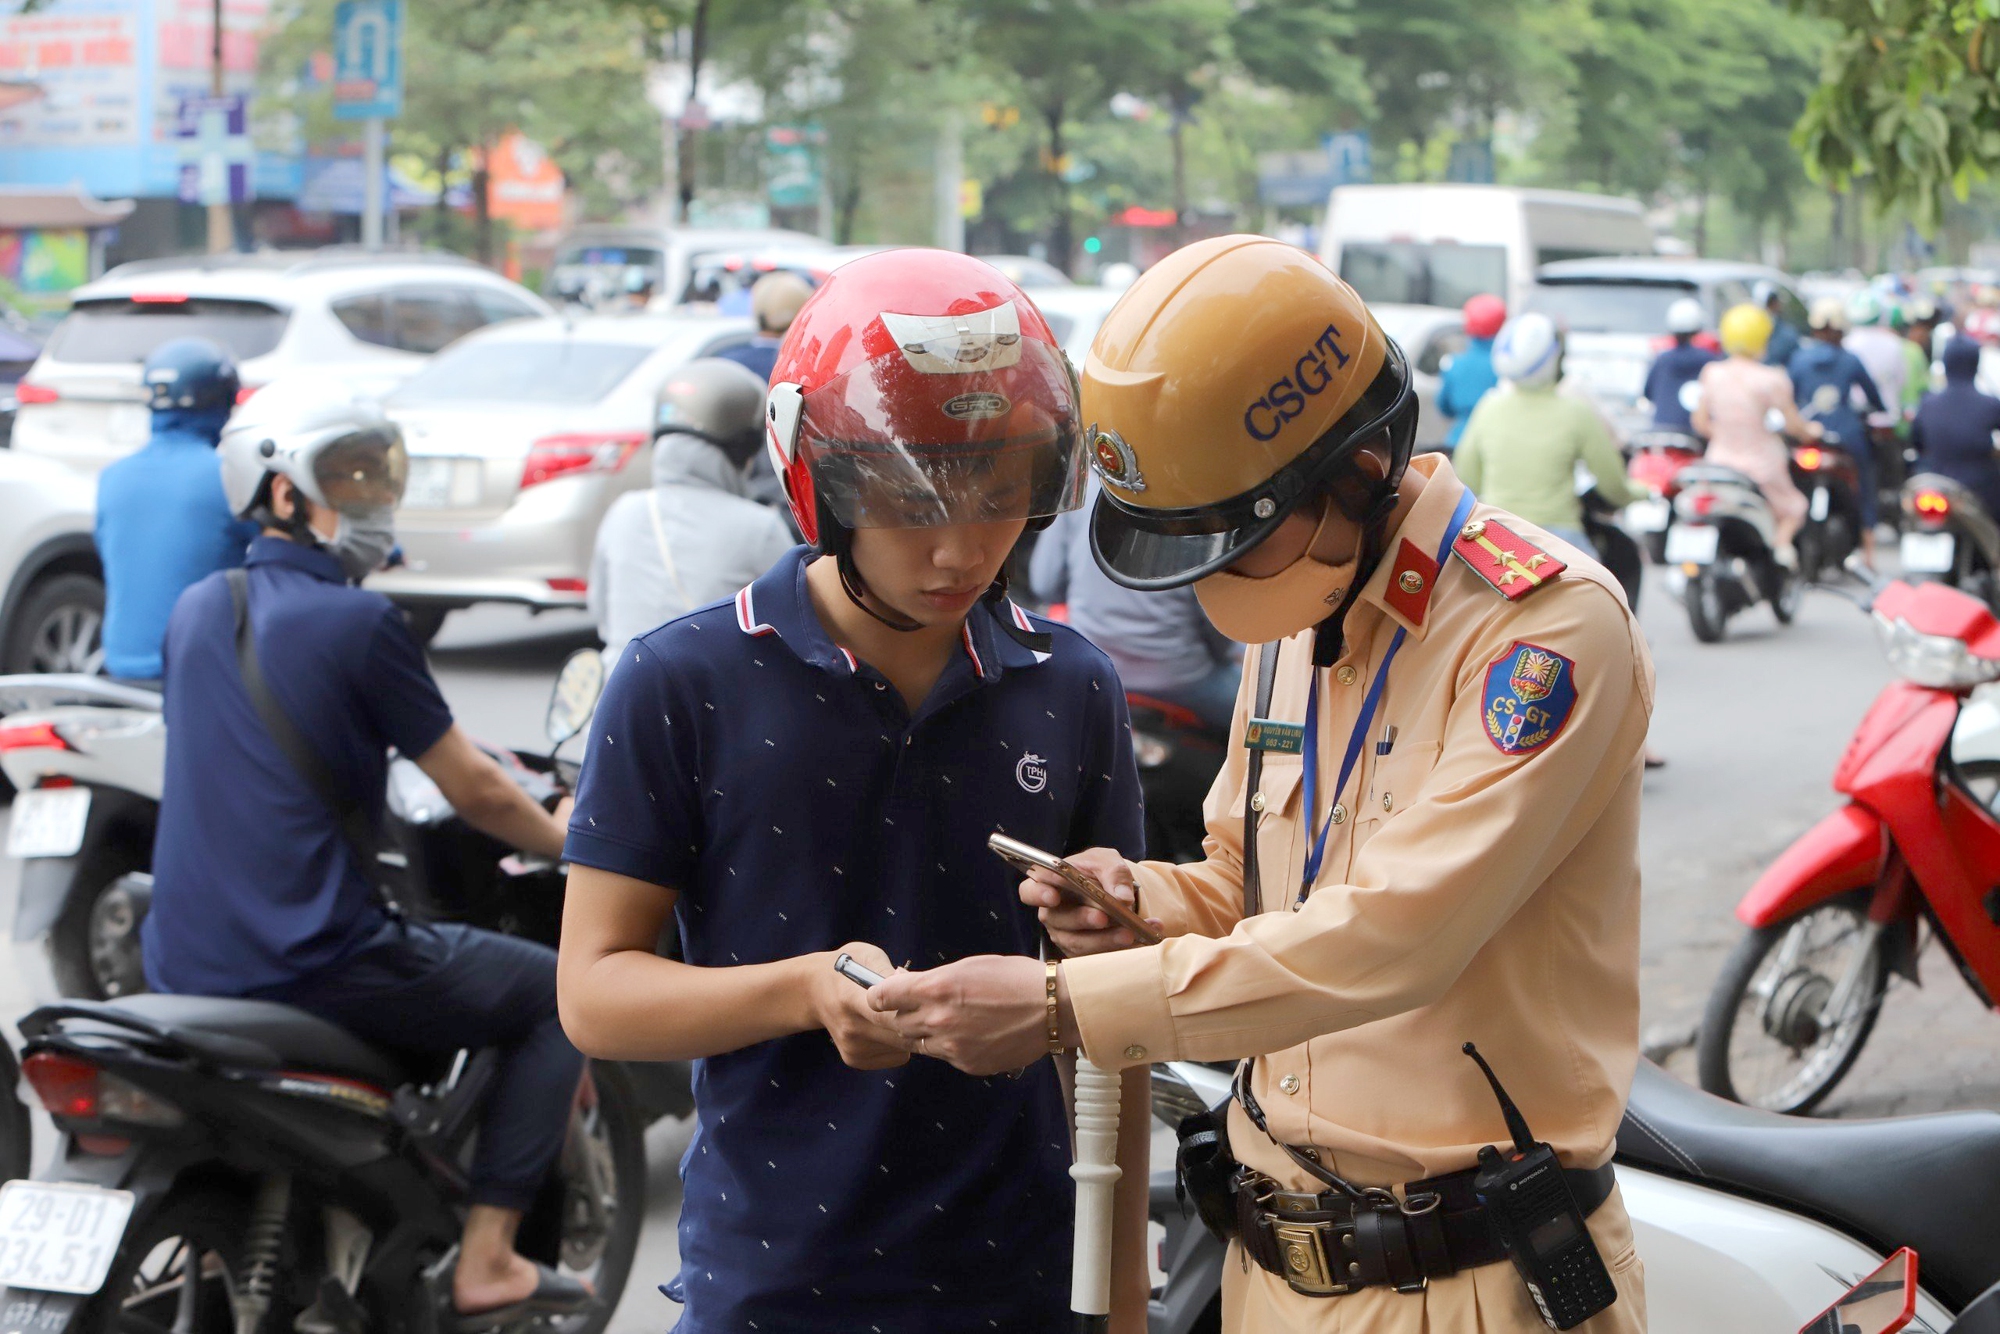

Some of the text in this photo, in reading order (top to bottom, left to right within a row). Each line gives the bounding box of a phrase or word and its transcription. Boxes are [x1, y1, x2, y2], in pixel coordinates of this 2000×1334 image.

[1244, 323, 1350, 442] CSGT
[950, 399, 1002, 412] GRO
[1492, 696, 1552, 728] CS GT
[1025, 764, 1044, 777] TPH
[1517, 1164, 1549, 1186] MOTOROLA
